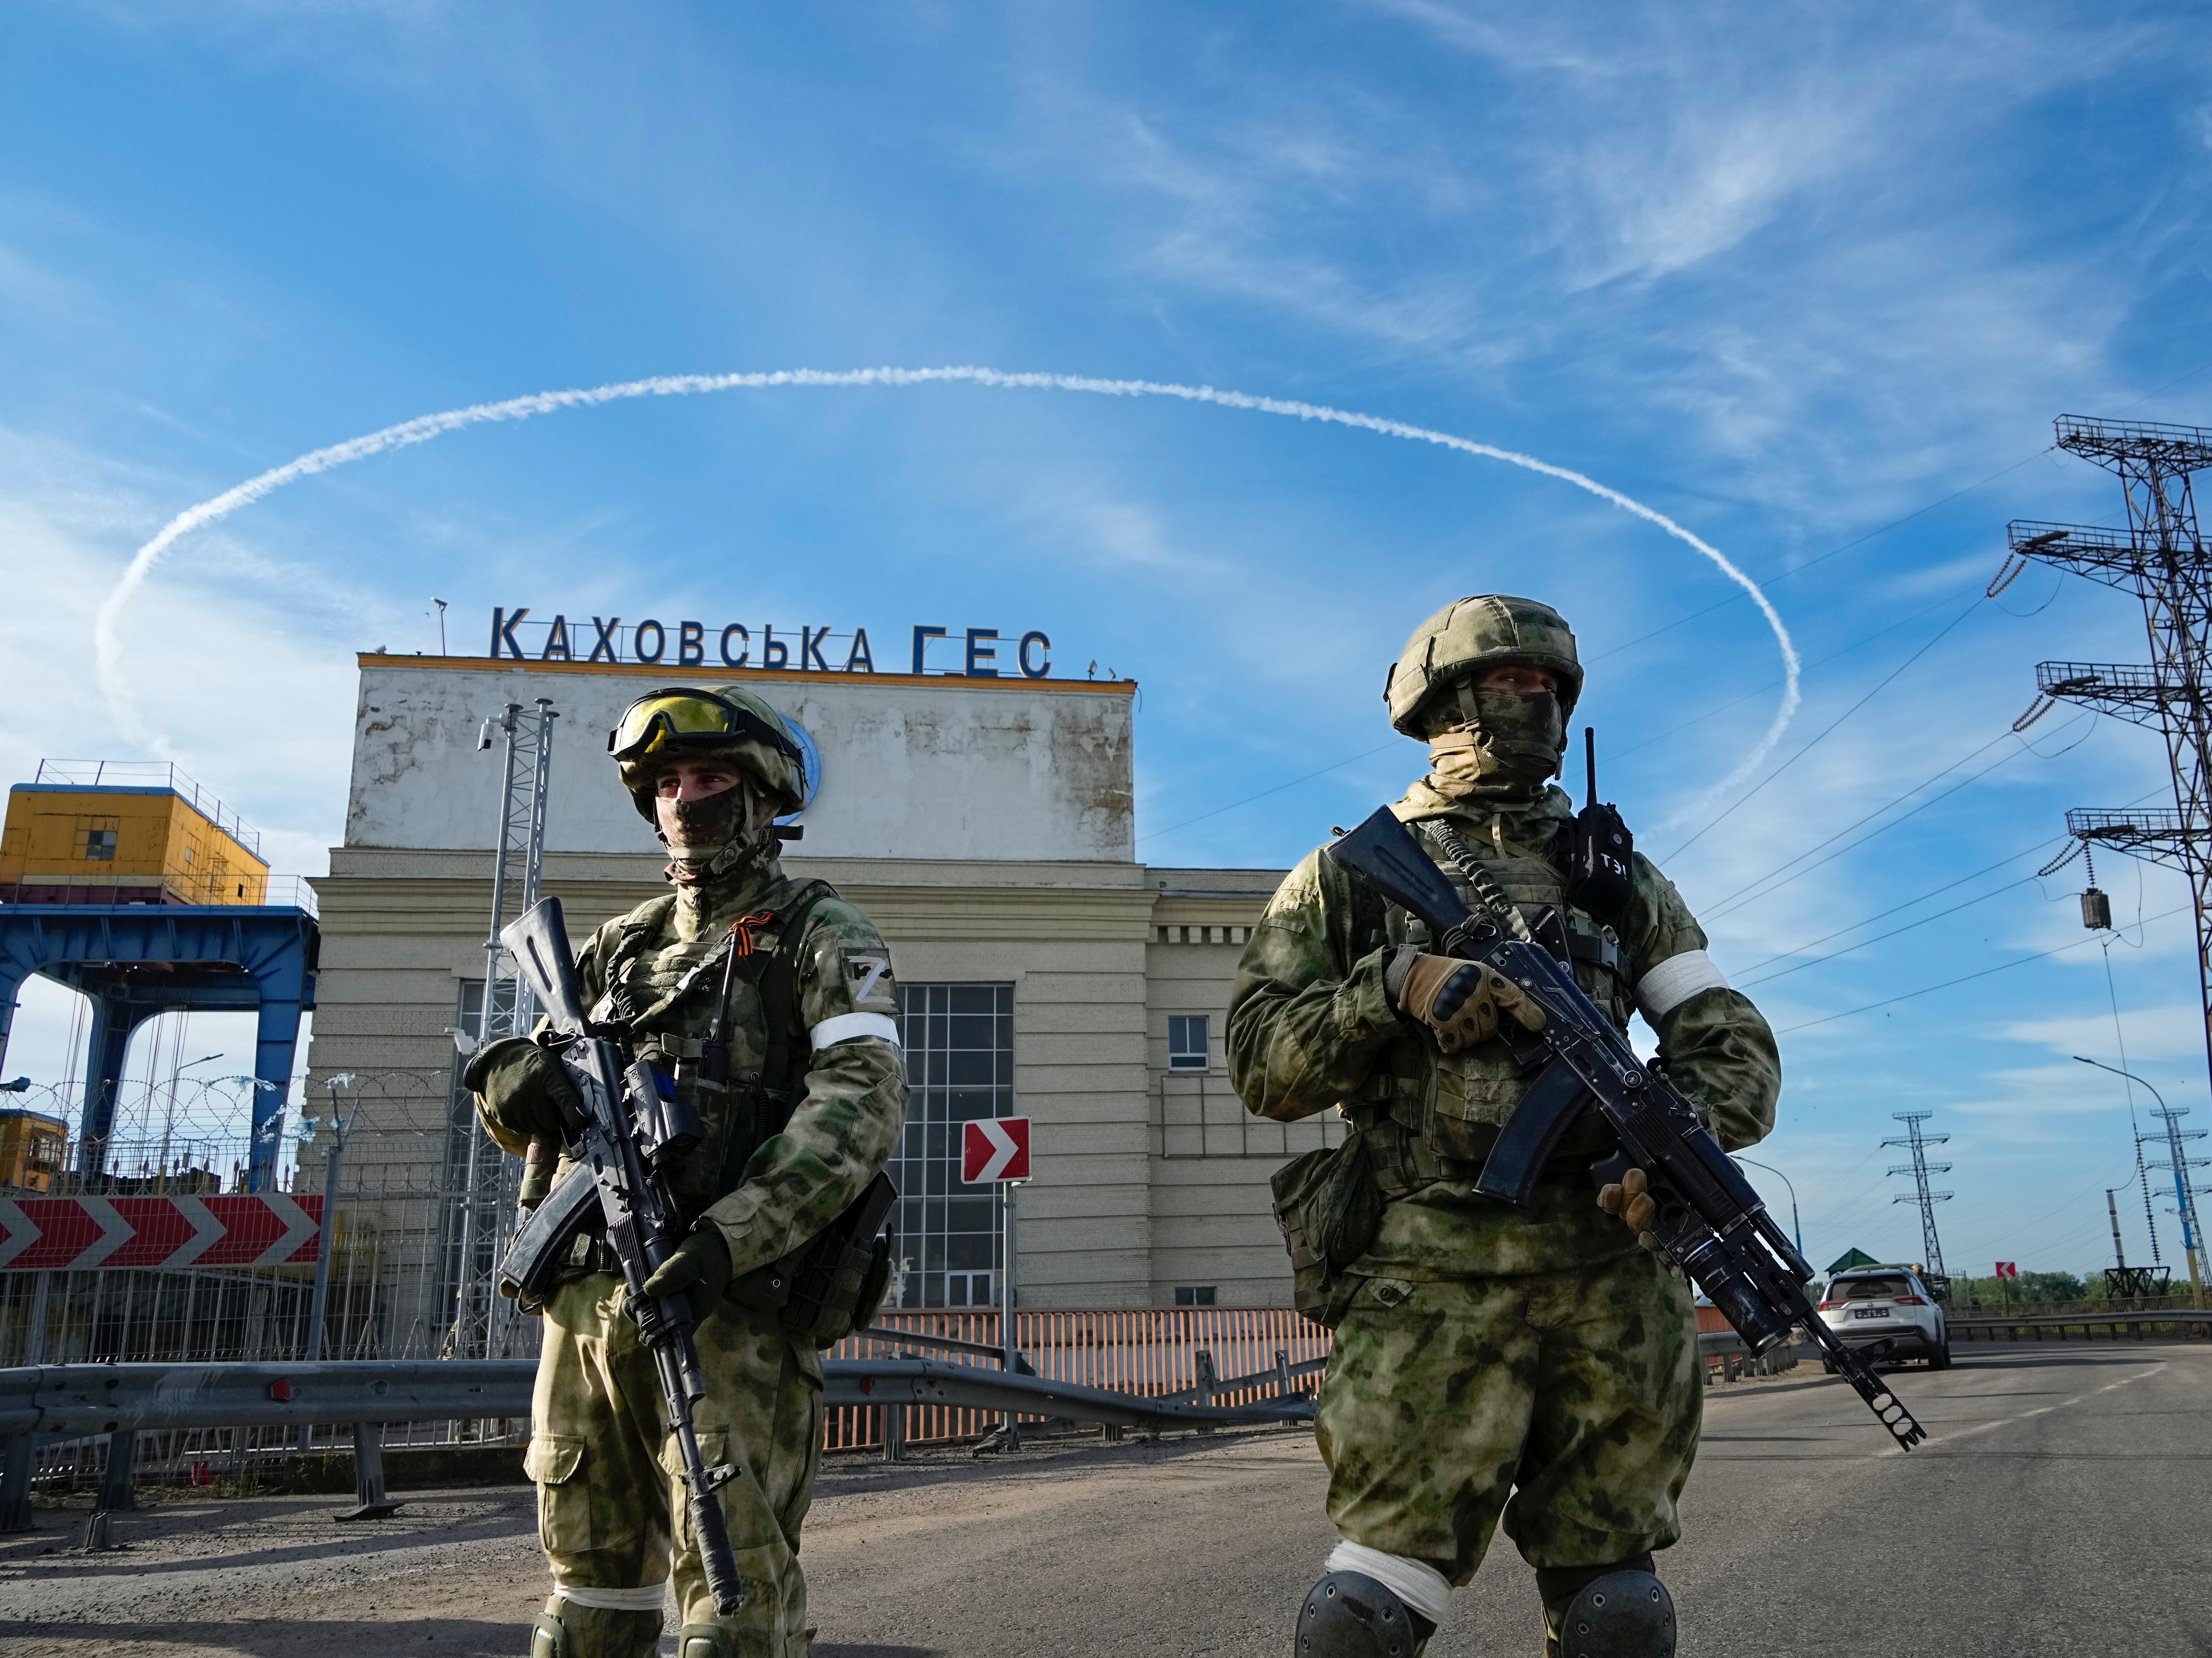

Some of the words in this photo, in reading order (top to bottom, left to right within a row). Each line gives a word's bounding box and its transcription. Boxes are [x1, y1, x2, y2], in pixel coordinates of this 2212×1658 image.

[490, 607, 875, 674] КАХОВСЬКА
[912, 625, 1051, 679] ГЕС
[845, 955, 896, 1004] Z
